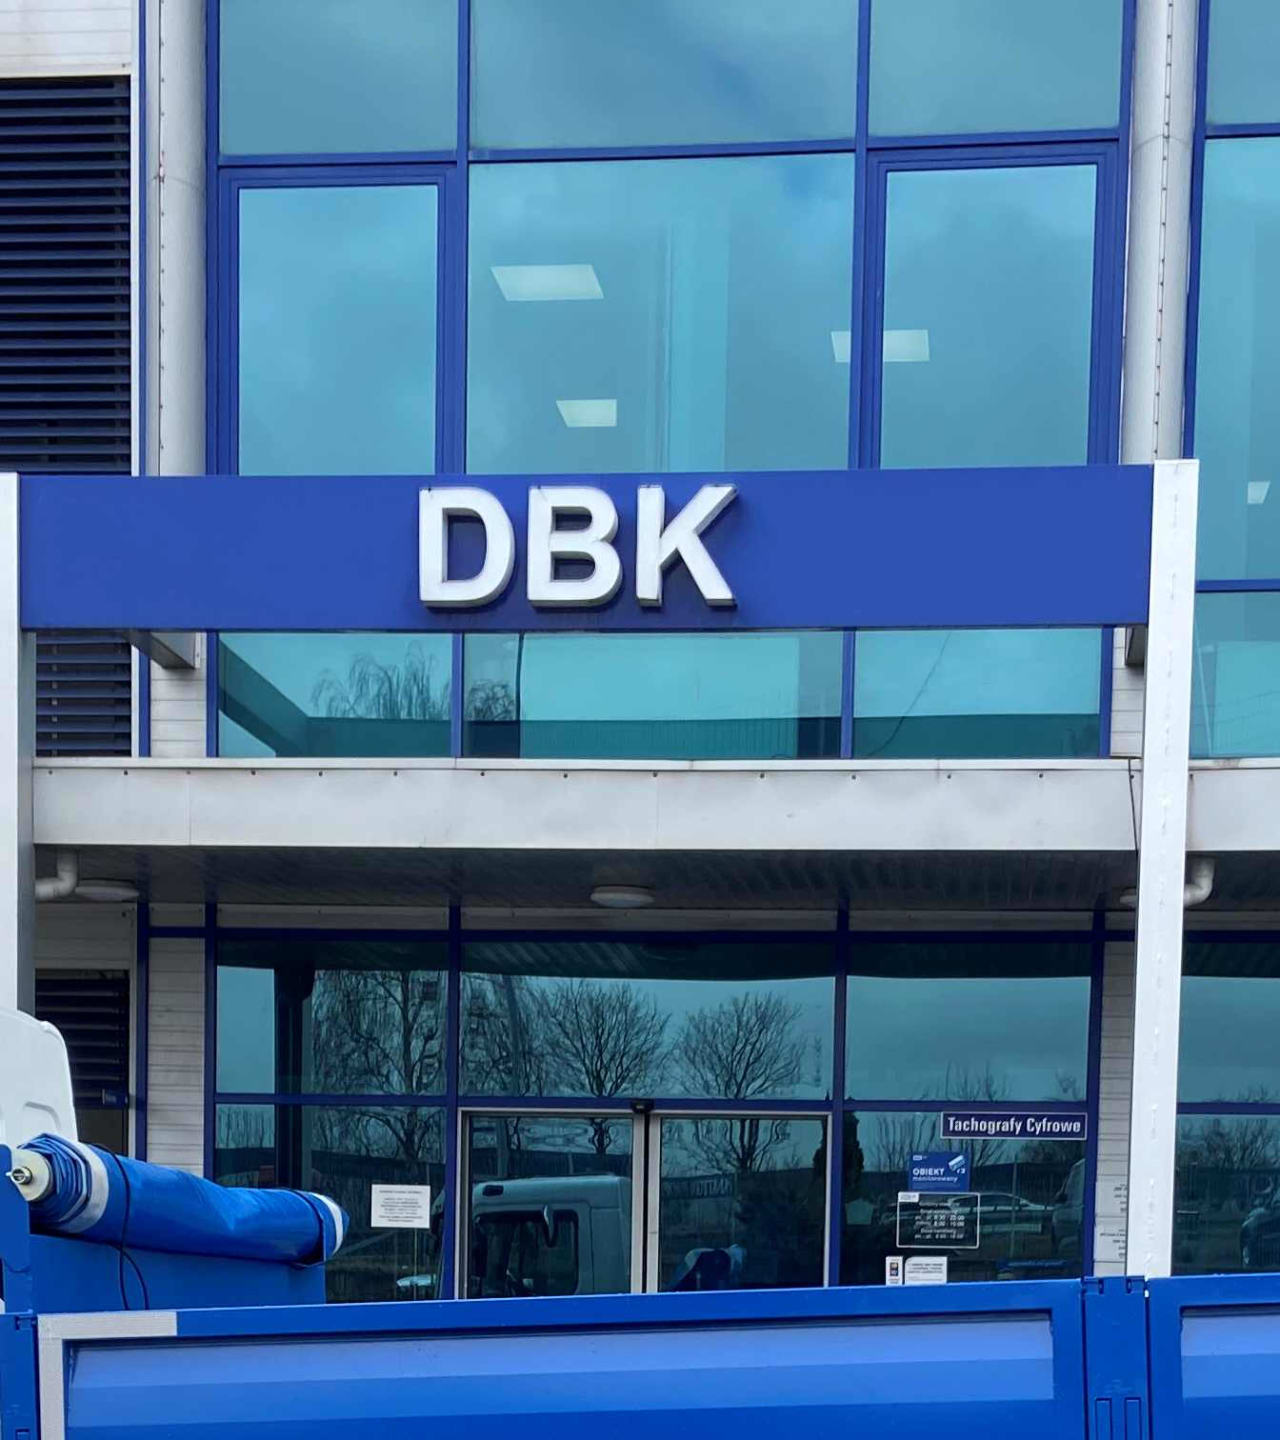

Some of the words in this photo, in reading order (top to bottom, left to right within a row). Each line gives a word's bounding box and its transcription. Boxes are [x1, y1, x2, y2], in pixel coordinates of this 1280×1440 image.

[418, 483, 738, 608] DBK
[947, 1116, 1022, 1135] Tachografy
[1026, 1117, 1081, 1134] Cyfrowe
